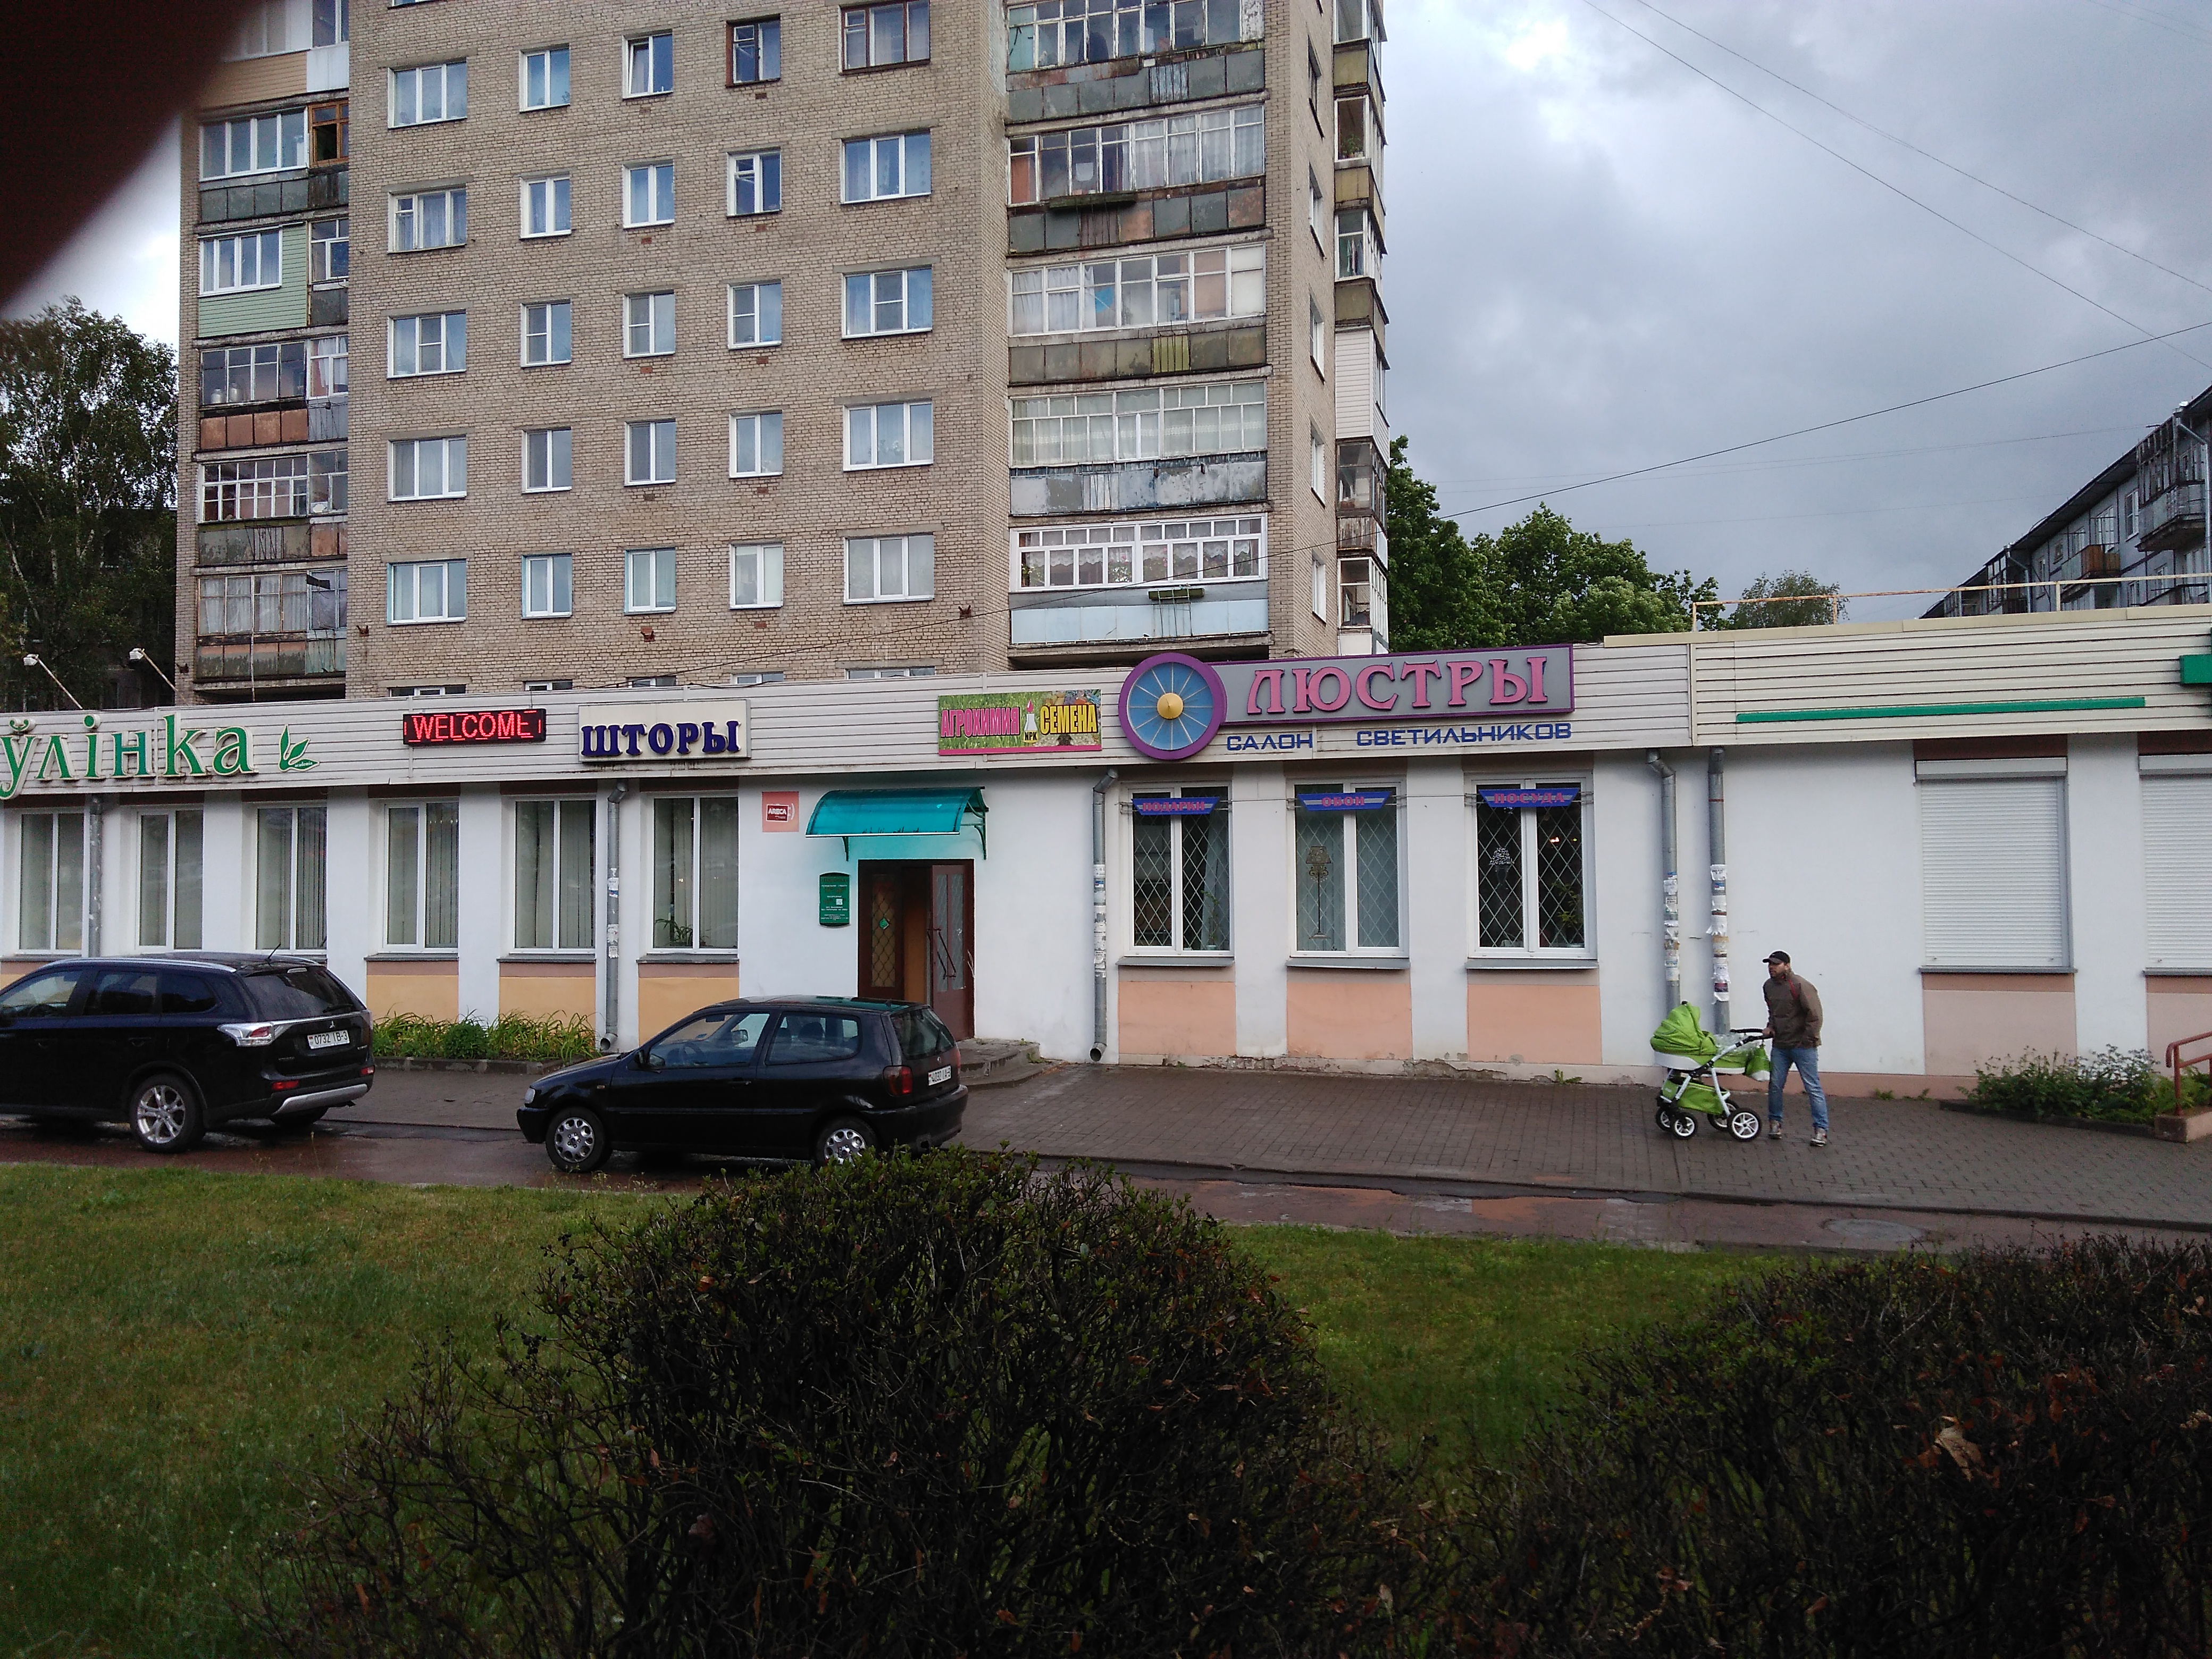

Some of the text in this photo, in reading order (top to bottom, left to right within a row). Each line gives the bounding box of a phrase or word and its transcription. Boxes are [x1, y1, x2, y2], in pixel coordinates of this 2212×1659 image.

[1247, 657, 1548, 715] ЛЮСТРЫ
[413, 713, 531, 740] WELCOME
[941, 707, 1020, 738] АГРОХИМИЯ
[1040, 704, 1098, 735] СЕМЕНА
[581, 720, 742, 757] ШТОРЫ
[1025, 731, 1037, 741] NPK
[1227, 723, 1572, 751] САЛОН СВЕТИЛЬНИКОВ
[1143, 801, 1205, 812] ПОДАРКИ
[1321, 797, 1365, 807] ОБОИ
[1494, 792, 1565, 804] ПОСУДА
[314, 1034, 331, 1044] 0732
